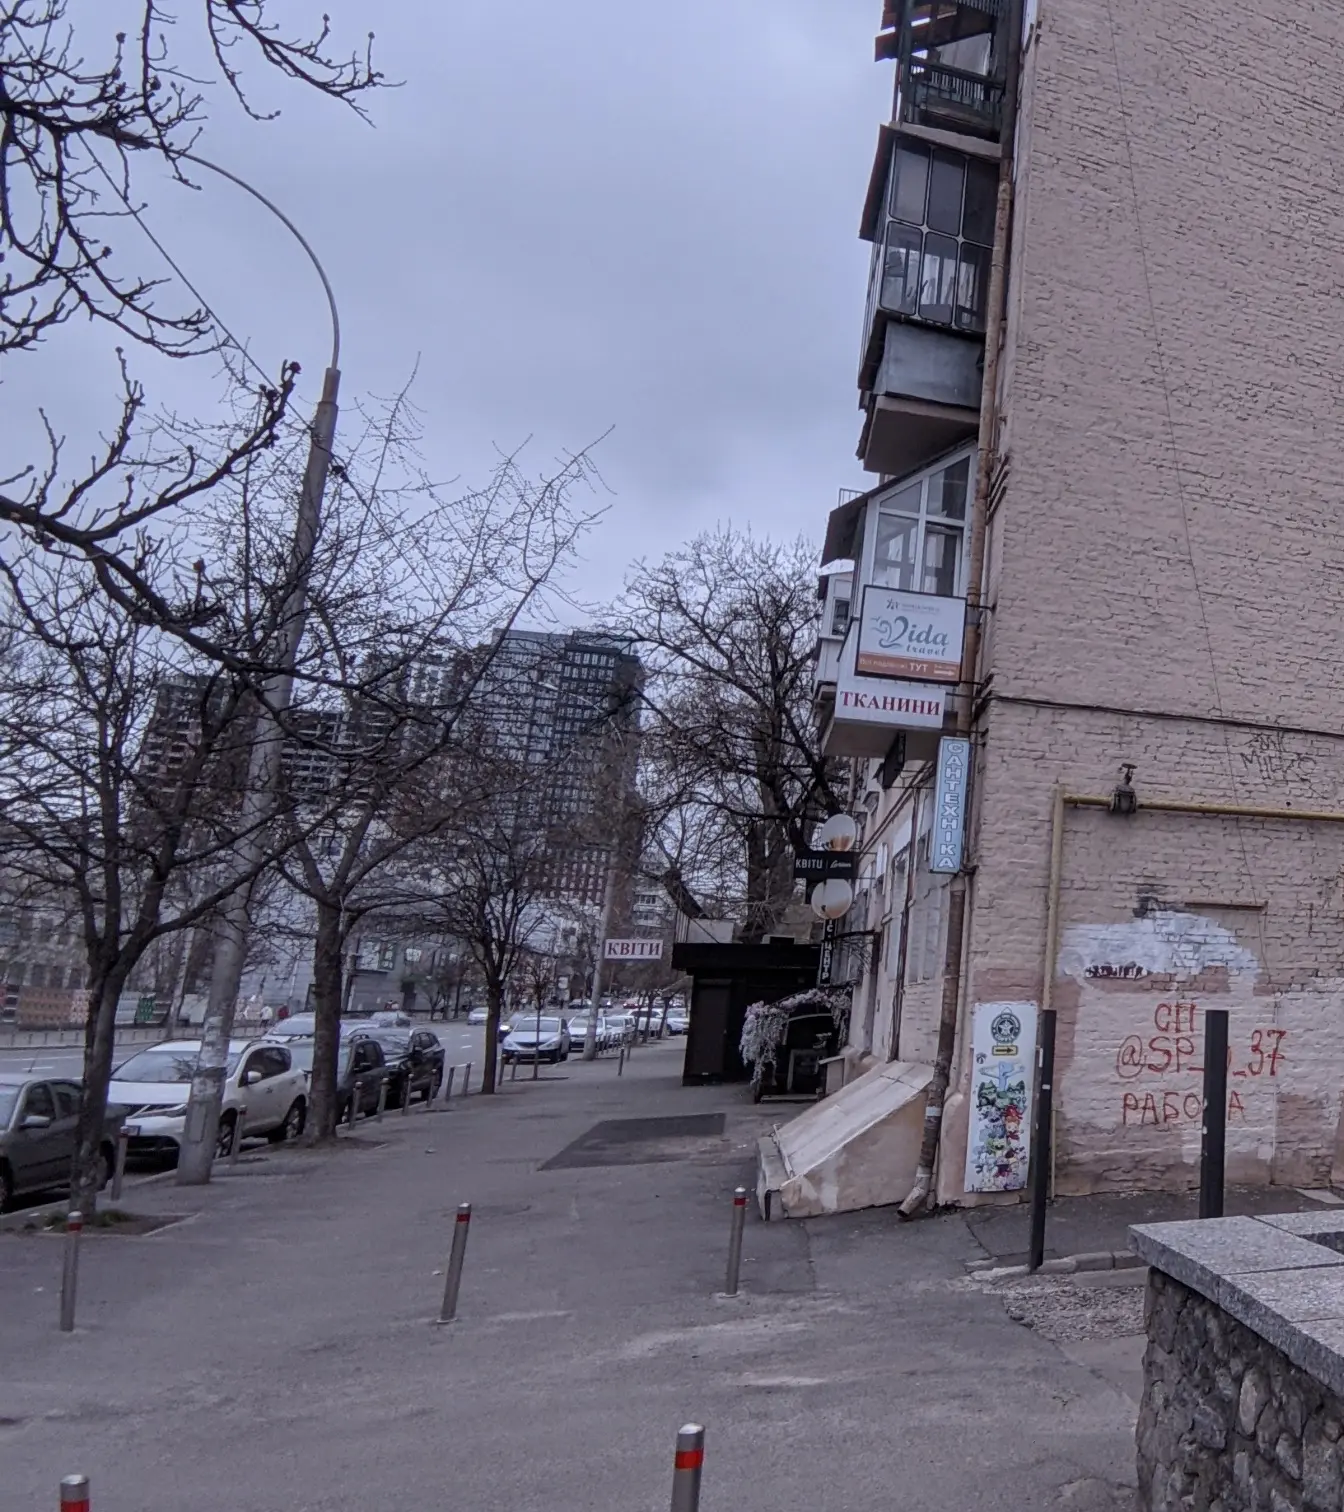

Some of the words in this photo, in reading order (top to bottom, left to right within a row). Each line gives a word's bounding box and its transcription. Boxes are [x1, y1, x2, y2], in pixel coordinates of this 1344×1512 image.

[877, 615, 949, 649] Vida
[906, 644, 946, 657] travel
[909, 662, 929, 673] ТУТ
[840, 690, 940, 716] ТКАНИНИ
[937, 743, 964, 868] САНТЕХНІКА
[607, 942, 661, 956] КВІТИ
[1122, 1090, 1247, 1125] РАБОА
